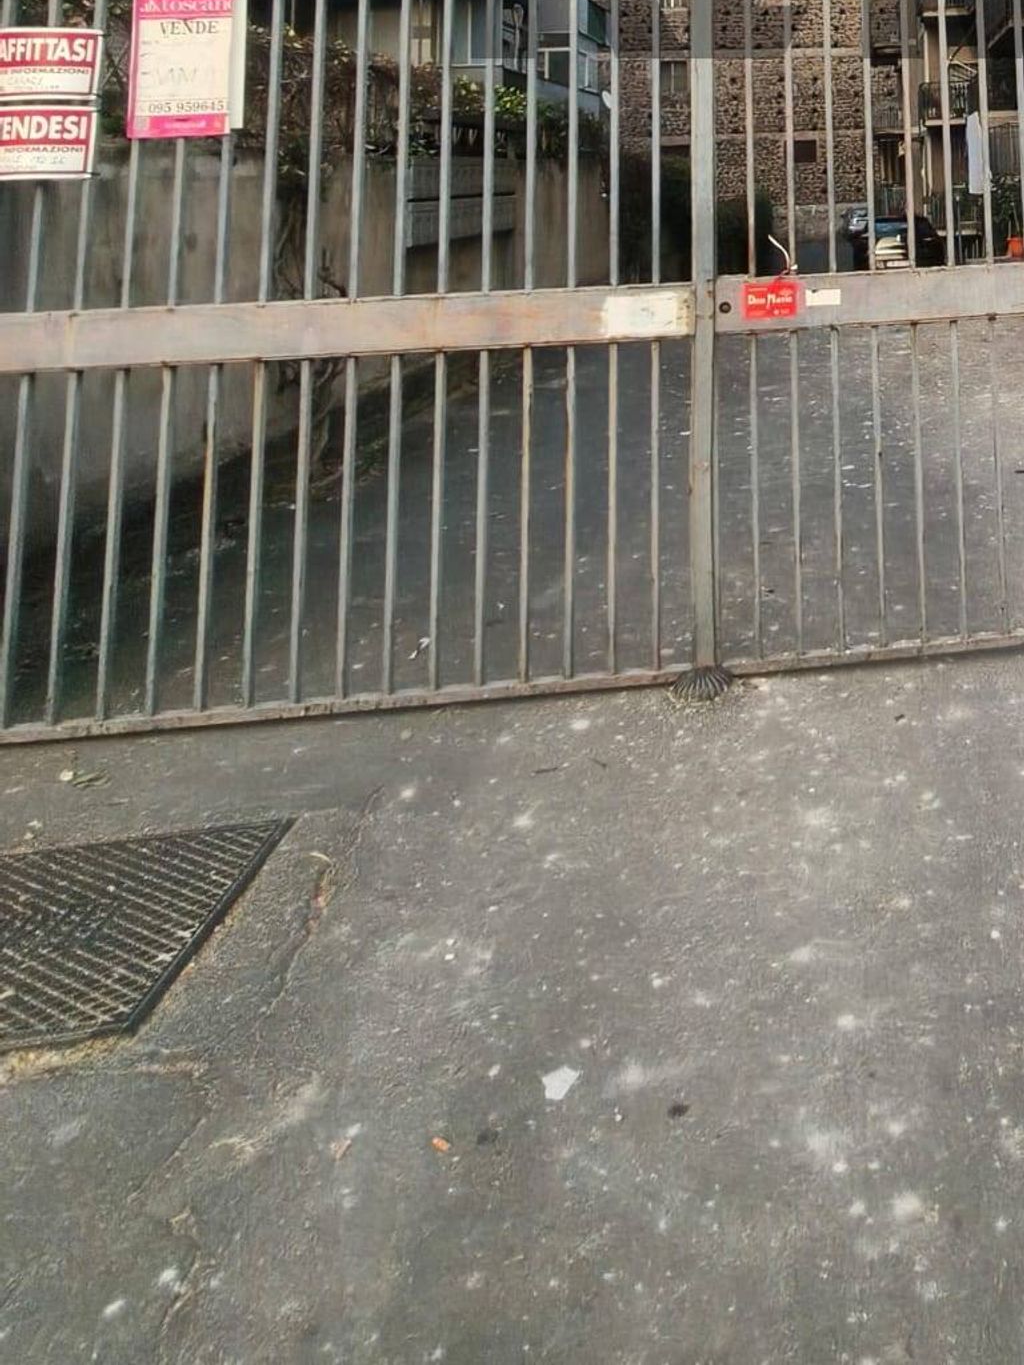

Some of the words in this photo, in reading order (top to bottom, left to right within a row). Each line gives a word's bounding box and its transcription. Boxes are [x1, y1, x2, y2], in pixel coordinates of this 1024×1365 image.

[159, 20, 220, 36] VENDE
[0, 38, 95, 62] AFFITTASI
[0, 115, 88, 140] ENDESI
